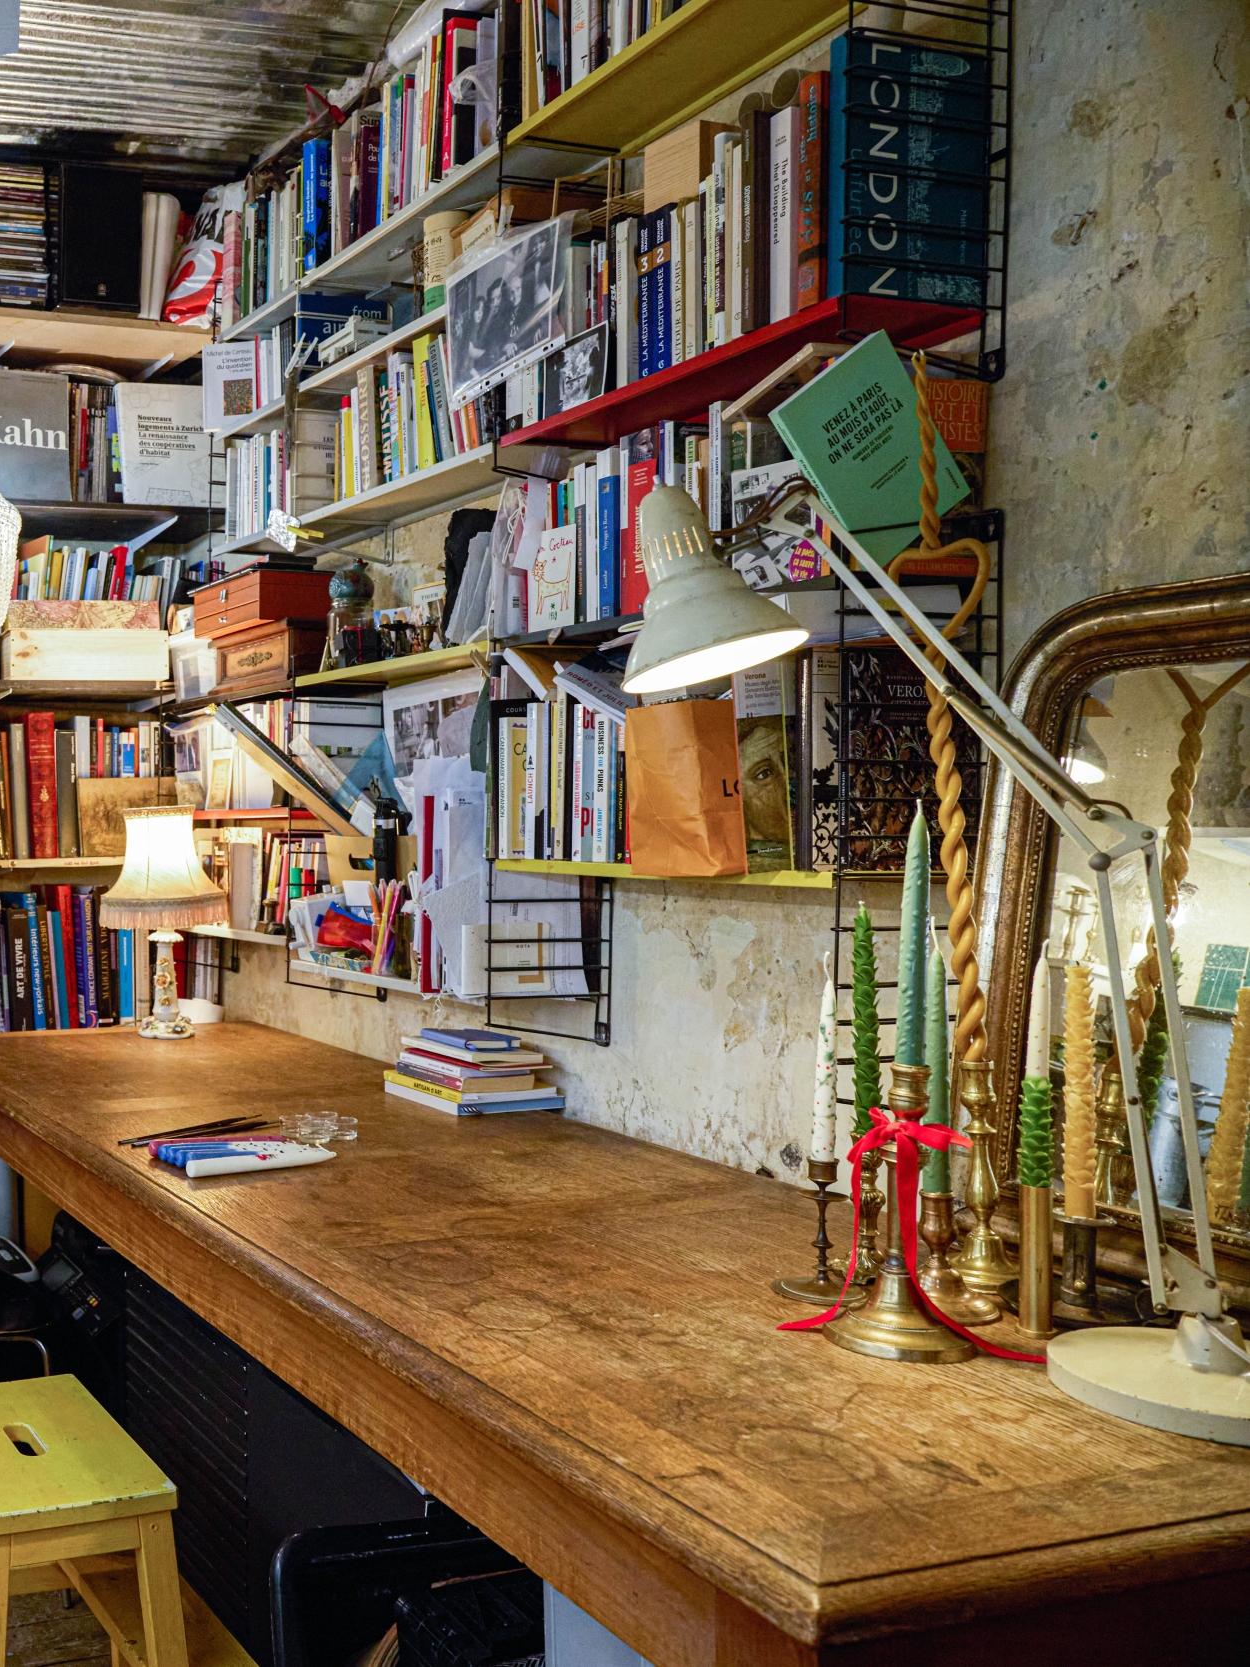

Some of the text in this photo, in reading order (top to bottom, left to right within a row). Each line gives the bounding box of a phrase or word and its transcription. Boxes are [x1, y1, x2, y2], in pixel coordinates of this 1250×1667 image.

[867, 43, 901, 296] LONDON
[779, 179, 788, 218] Building
[771, 184, 780, 245] Disappeared
[640, 256, 649, 272] 3
[656, 247, 664, 263] 2
[352, 305, 382, 319] from
[640, 275, 649, 347] MÉDITERRANÉE
[656, 267, 664, 337] MÉDITERRANÉE
[675, 296, 681, 312] DE
[643, 348, 649, 361] LA
[658, 339, 664, 353] LA
[221, 356, 252, 365] L'invention
[225, 361, 253, 371] quotidien
[429, 344, 443, 410] ECOLOGY OF FEAR
[924, 381, 981, 403] HISTOIRE
[821, 381, 882, 434] VENEZ À PARIS
[933, 402, 981, 422] RT ET
[137, 414, 172, 423] Nouveaux
[137, 422, 174, 432] logements
[181, 424, 204, 433] Zurich
[826, 392, 897, 449] AU MOIS D'AOÛT,
[148, 432, 188, 440] renaissance
[357, 369, 371, 492] GLOSSAIRE
[379, 385, 393, 475] MATISSE
[828, 397, 904, 465] ON NE SERA PAS LÀ
[936, 420, 980, 442] TISTES
[139, 448, 171, 457] d'habitat
[151, 440, 196, 450] coopératives
[635, 563, 644, 573] LA
[744, 672, 767, 681] Verona
[603, 693, 629, 710] JULIET
[887, 684, 929, 698] VERO
[597, 721, 605, 755] BUSINESS
[527, 773, 535, 804] LAUNCH
[597, 769, 605, 792] PUNKS
[86, 921, 92, 929] LA
[40, 920, 51, 979] LIBERTY STYLE
[15, 938, 24, 999] ART DE VIVRE
[30, 928, 44, 1016] Intérieurs new-yorkais
[101, 949, 110, 1000] MADELEINE
[413, 1082, 430, 1093] ARTISAN
